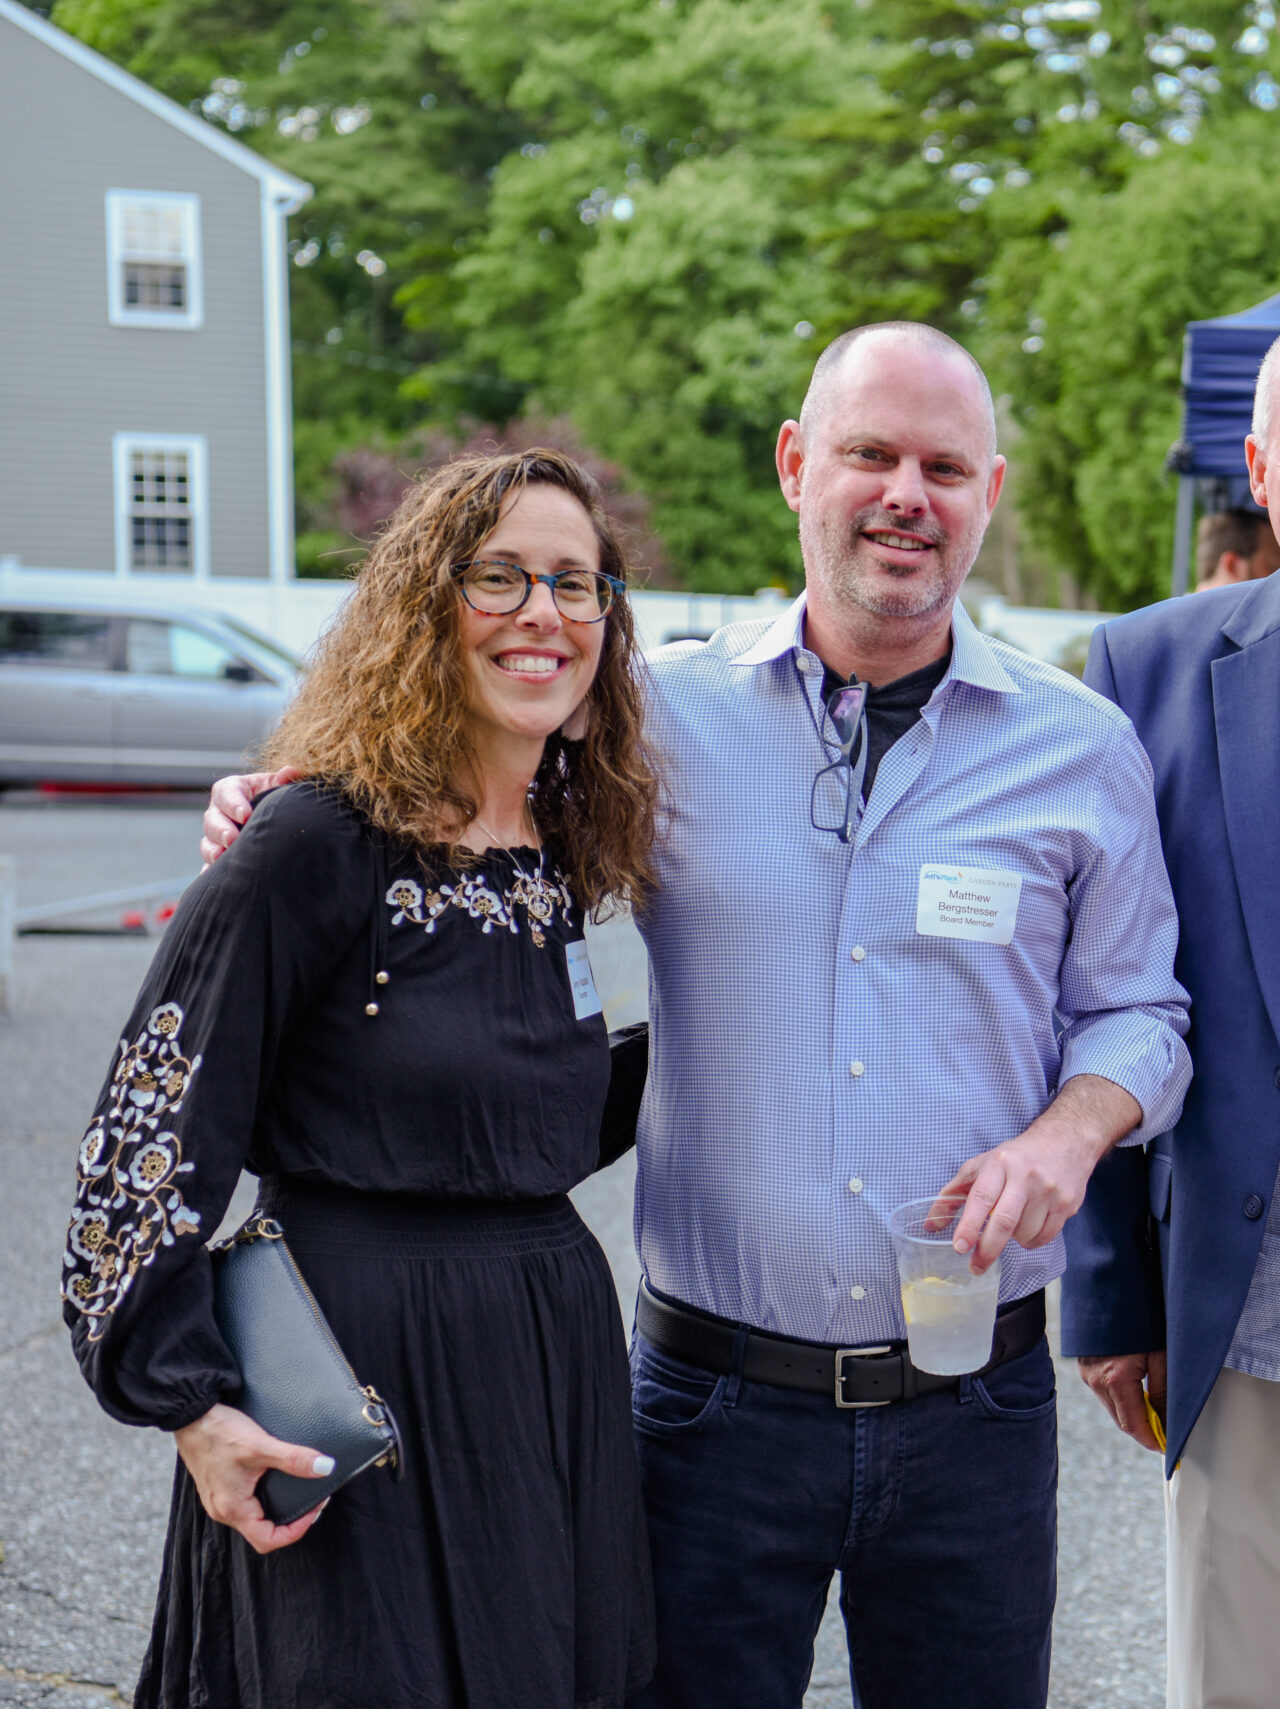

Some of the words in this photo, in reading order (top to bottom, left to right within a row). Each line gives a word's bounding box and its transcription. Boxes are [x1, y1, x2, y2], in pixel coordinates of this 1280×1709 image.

[949, 890, 991, 903] Matthew
[938, 902, 999, 917] Bergstresser
[940, 915, 963, 923] Board
[965, 918, 994, 928] Member
